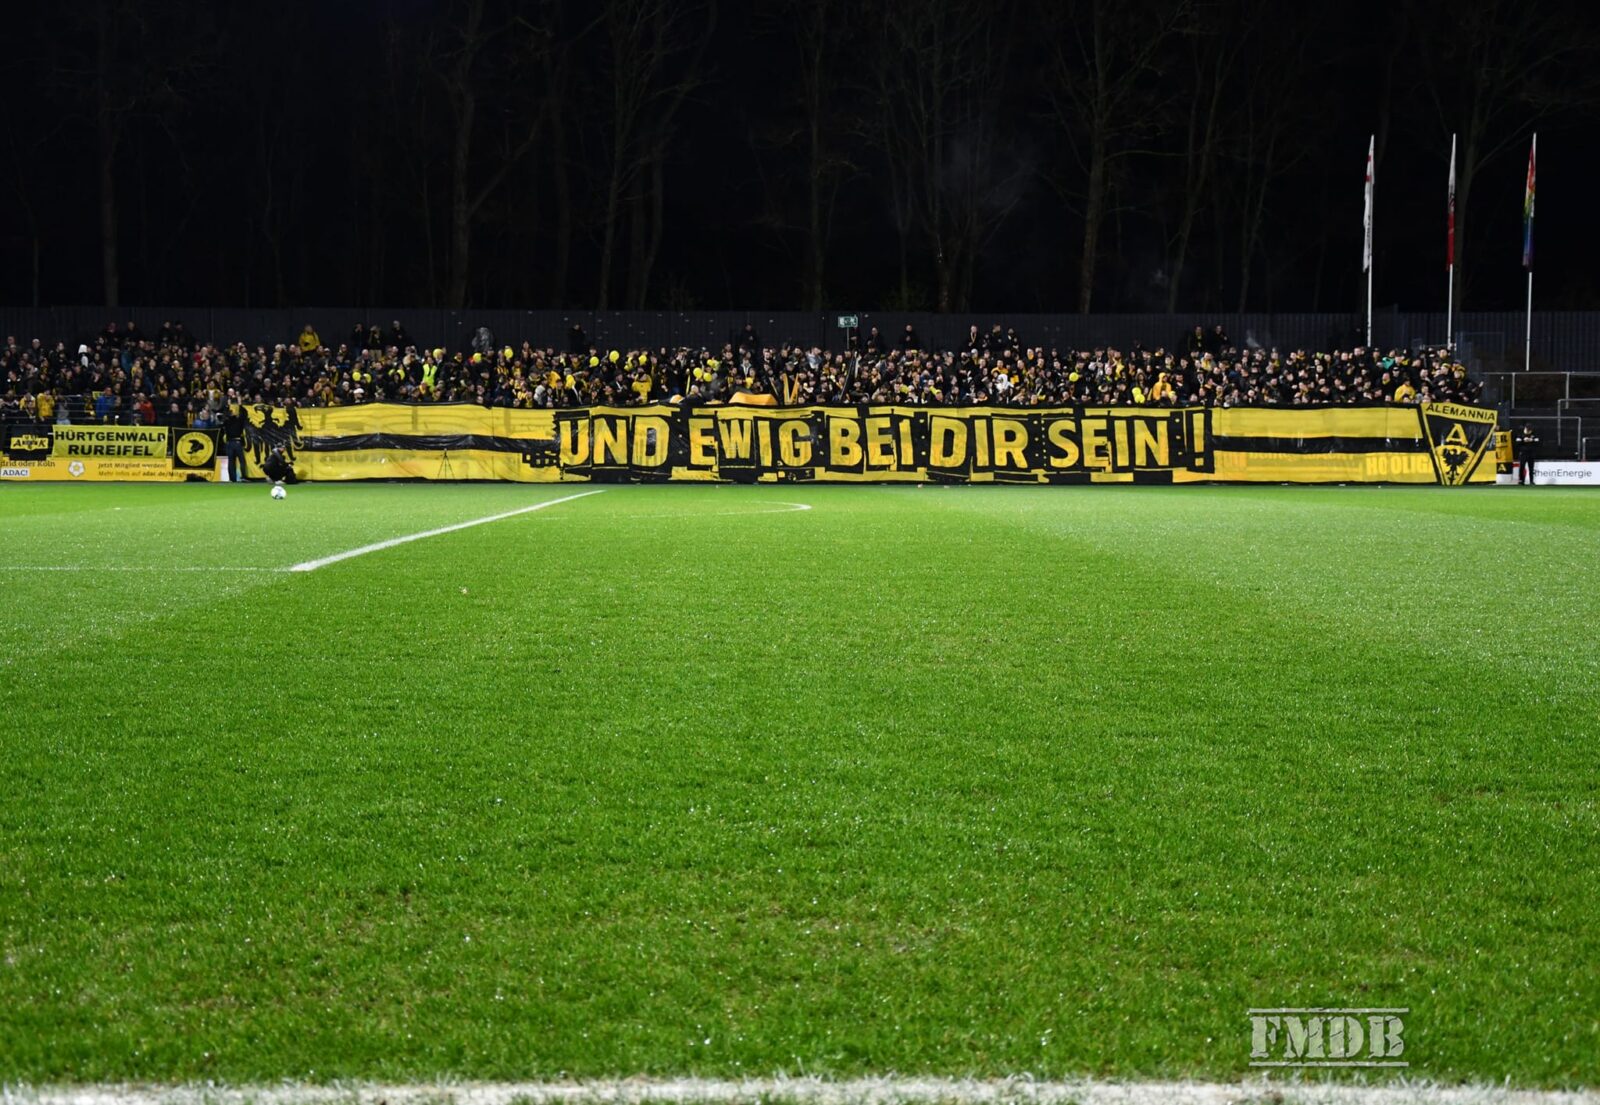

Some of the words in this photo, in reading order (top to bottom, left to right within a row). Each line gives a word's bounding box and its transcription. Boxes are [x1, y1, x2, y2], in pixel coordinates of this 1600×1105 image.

[1425, 403, 1495, 421] ALEMANNIA
[54, 429, 166, 442] HÜRTGENWALD
[559, 415, 670, 467] UND
[688, 417, 813, 467] EWIG
[829, 415, 913, 467] BEI
[929, 415, 1028, 468] DIR
[1048, 418, 1169, 467] SEIN
[1445, 423, 1469, 445] A
[68, 445, 154, 456] RUREIFEL
